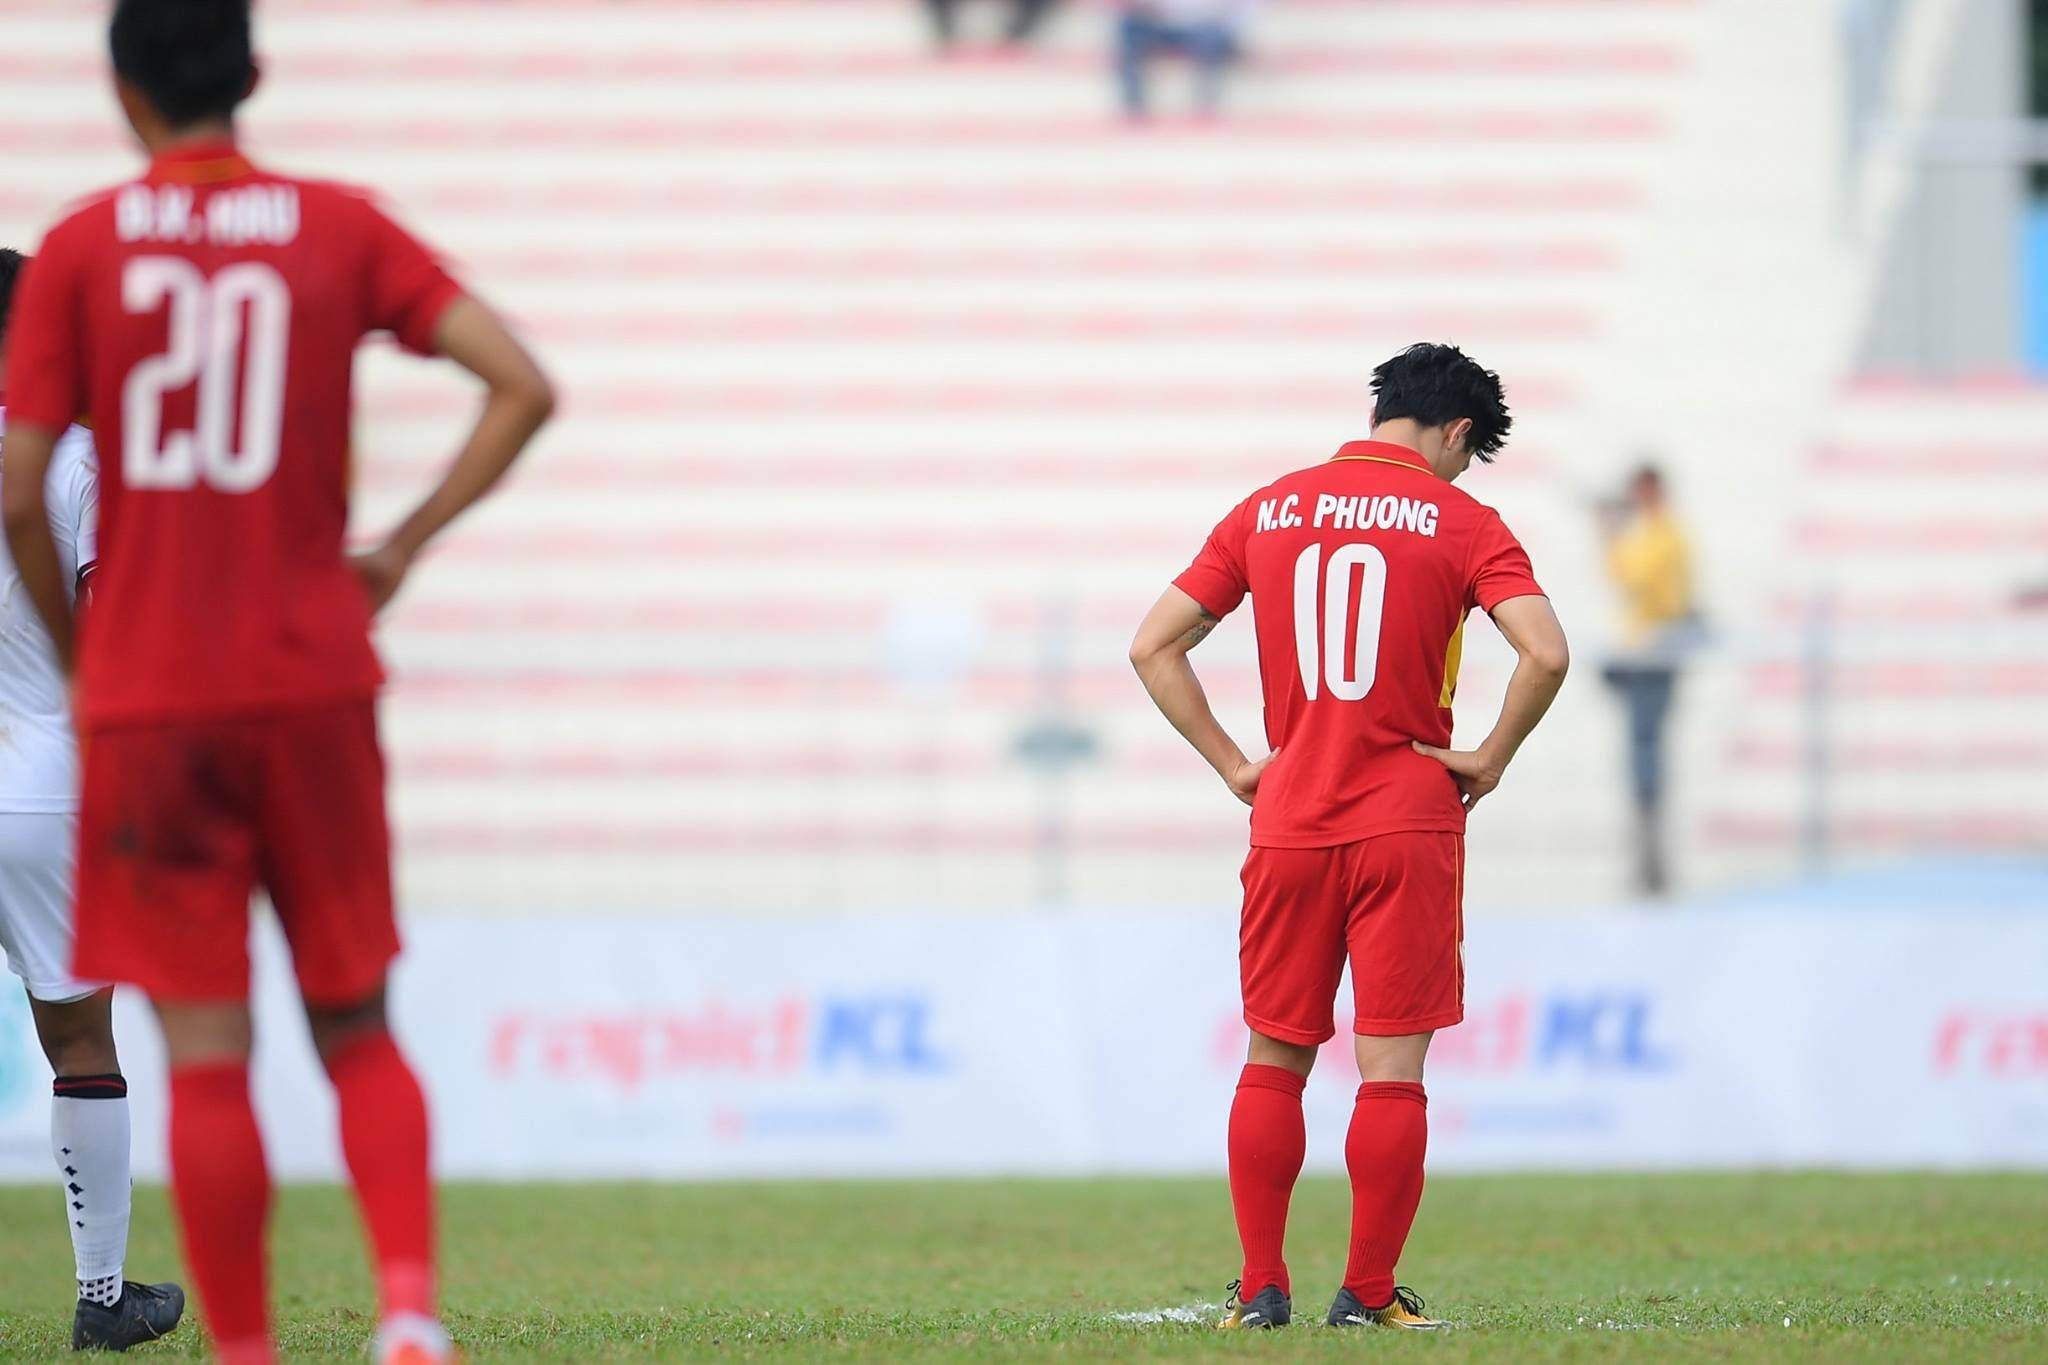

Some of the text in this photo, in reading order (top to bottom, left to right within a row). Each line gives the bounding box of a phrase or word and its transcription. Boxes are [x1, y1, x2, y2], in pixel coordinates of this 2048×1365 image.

[121, 254, 291, 493] 20
[1256, 493, 1440, 537] N.C. PHUONG
[1293, 542, 1388, 701] 10
